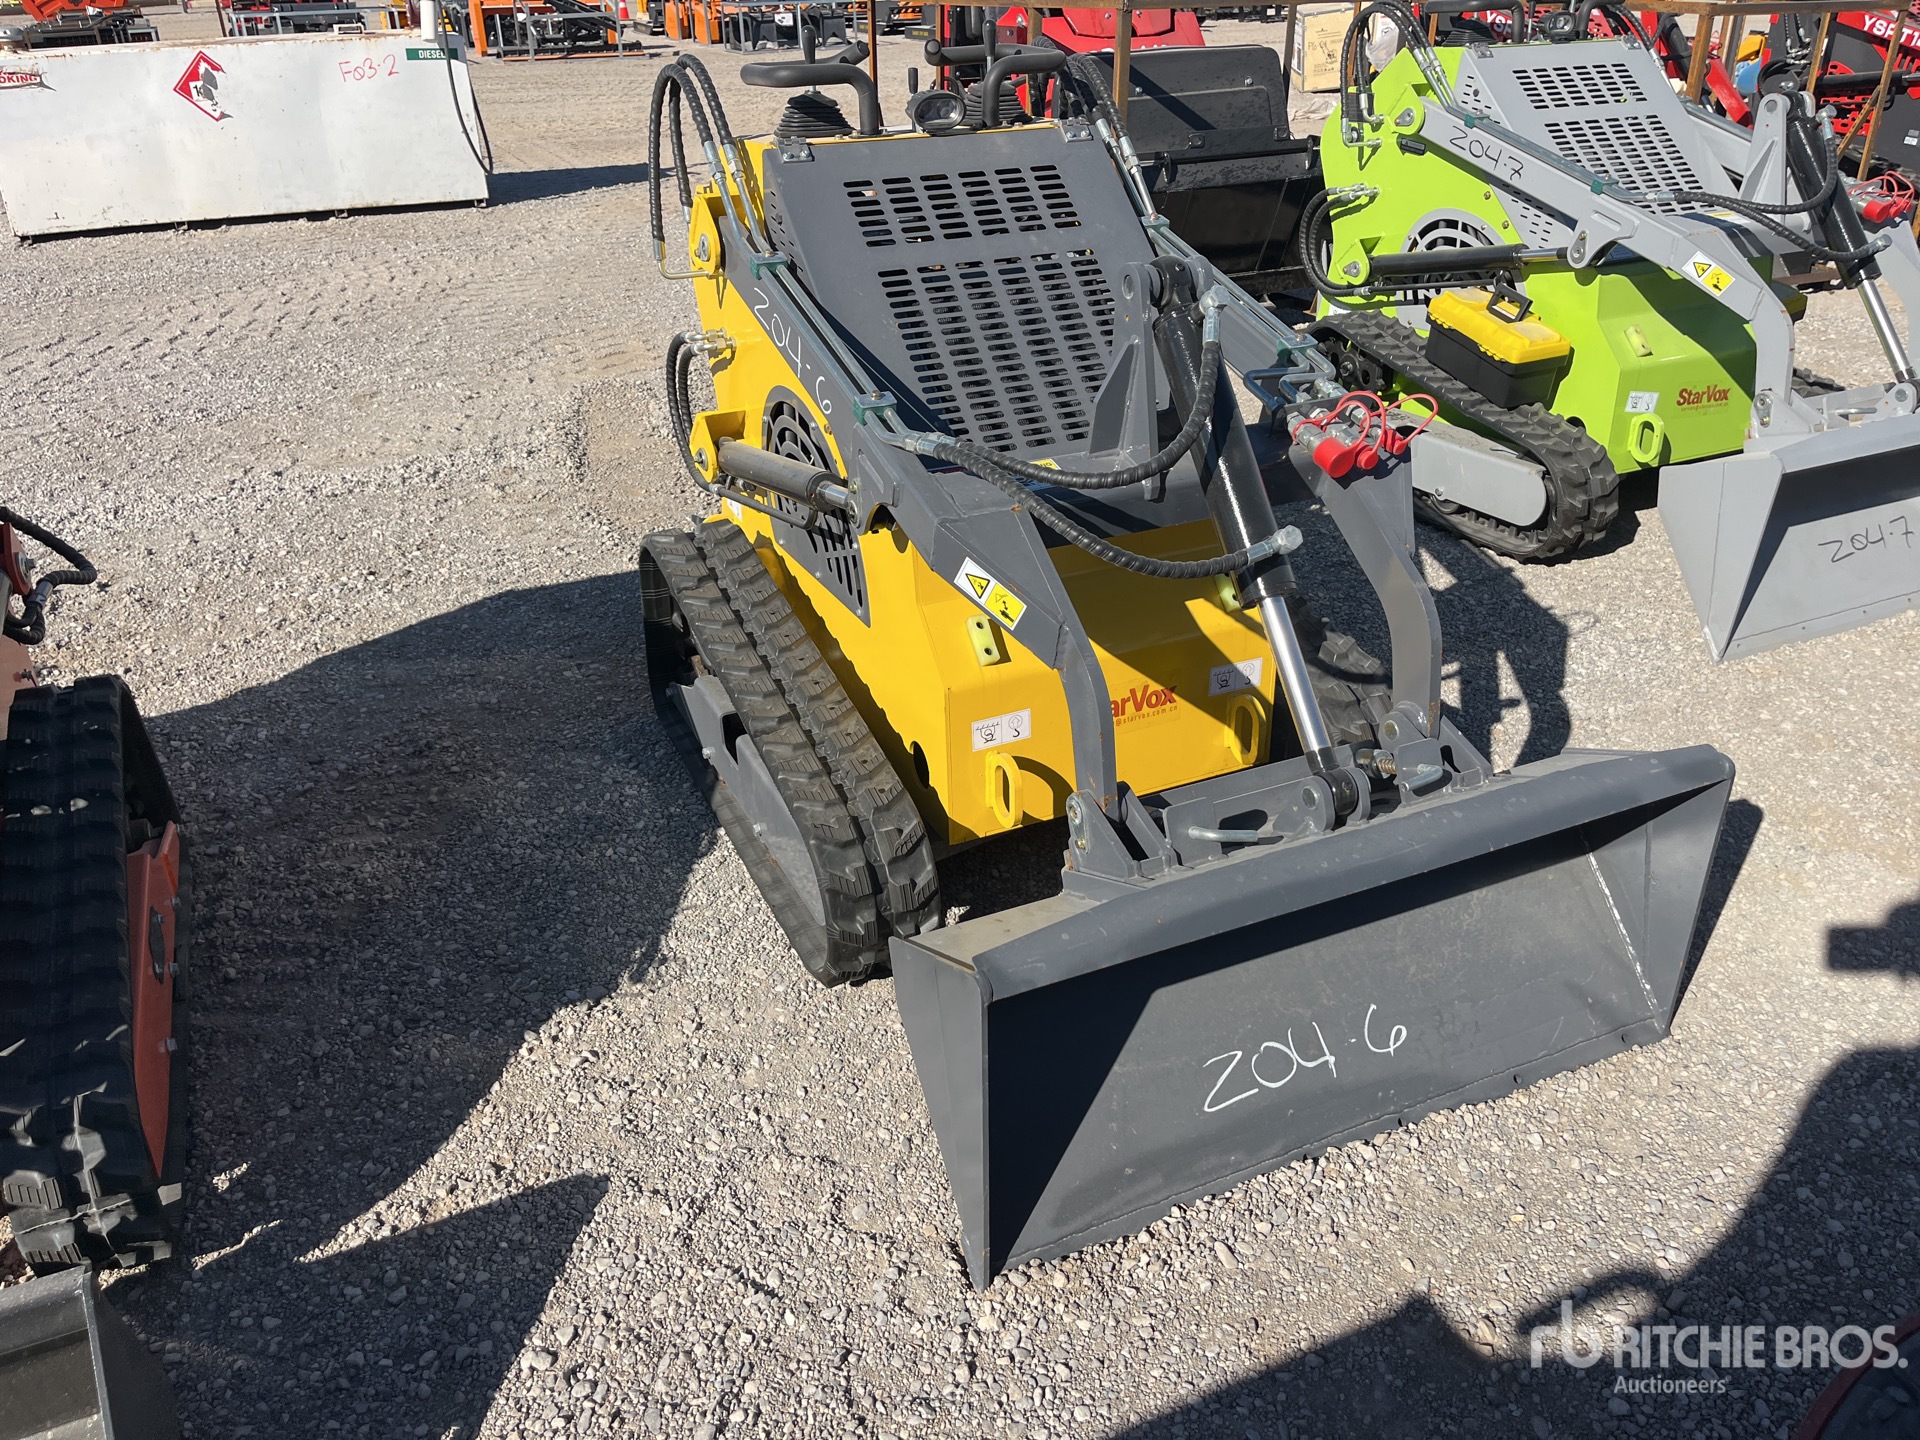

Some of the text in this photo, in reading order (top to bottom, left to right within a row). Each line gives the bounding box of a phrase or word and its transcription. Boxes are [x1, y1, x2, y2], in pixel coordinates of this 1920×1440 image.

[418, 49, 446, 59] DIESEL
[1676, 384, 1731, 406] StarVox
[1111, 684, 1178, 718] arVox
